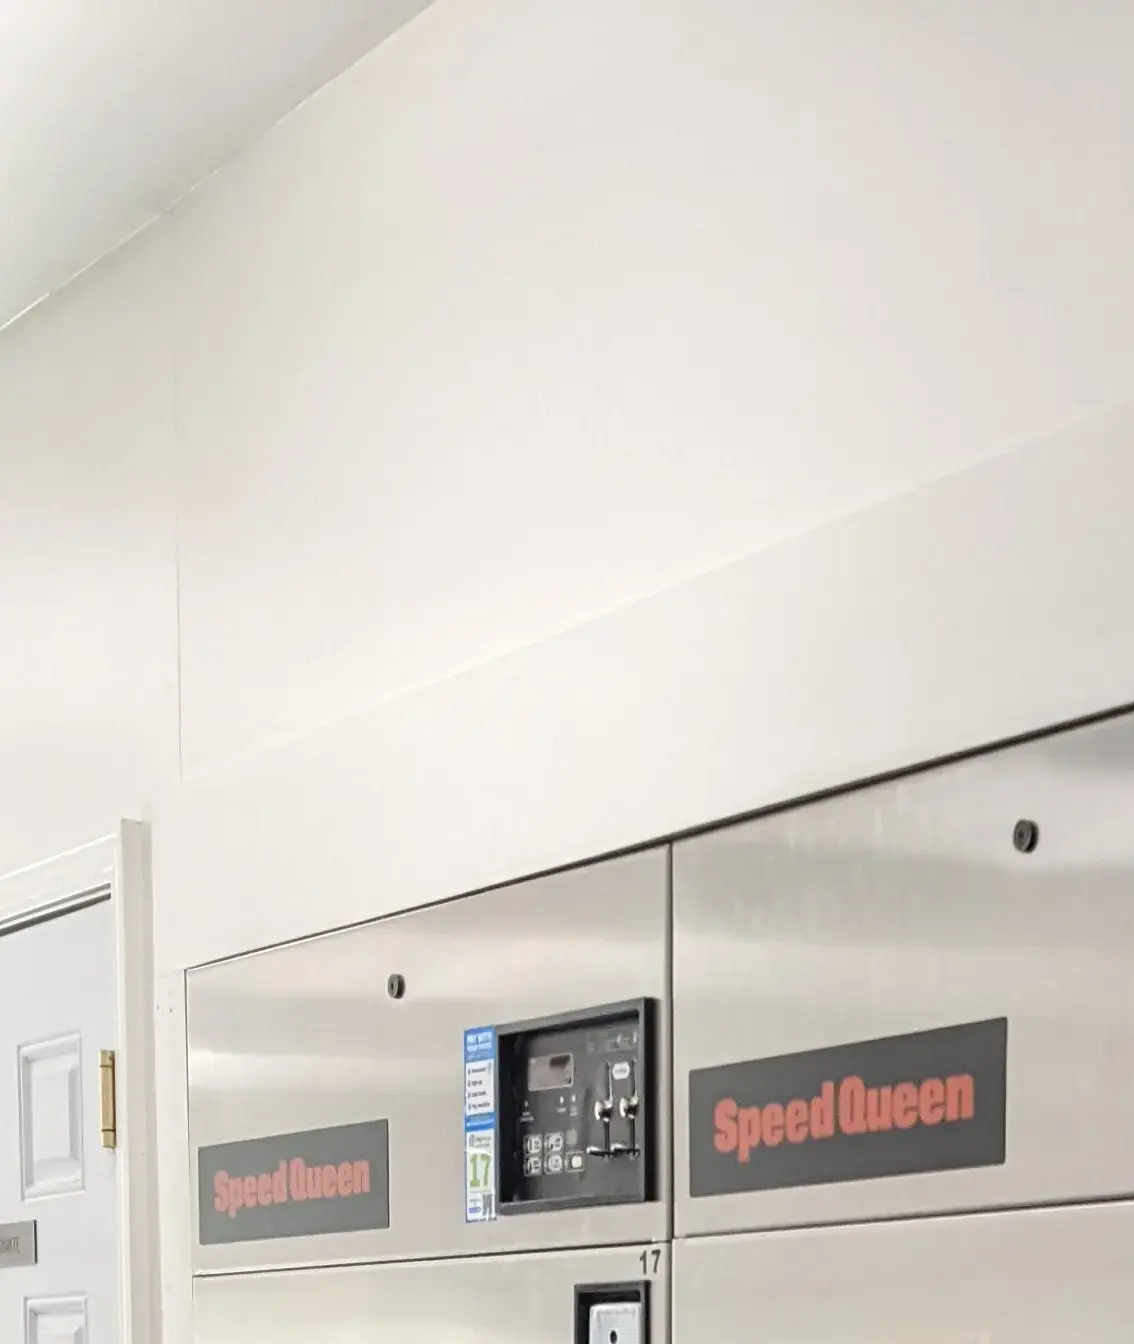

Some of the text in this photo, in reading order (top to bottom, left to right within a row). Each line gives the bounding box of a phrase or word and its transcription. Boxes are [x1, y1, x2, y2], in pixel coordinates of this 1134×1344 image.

[714, 1073, 975, 1163] Speed Queen
[214, 1156, 371, 1219] Speed Queen
[469, 1153, 492, 1188] 17
[639, 1249, 661, 1274] 17
